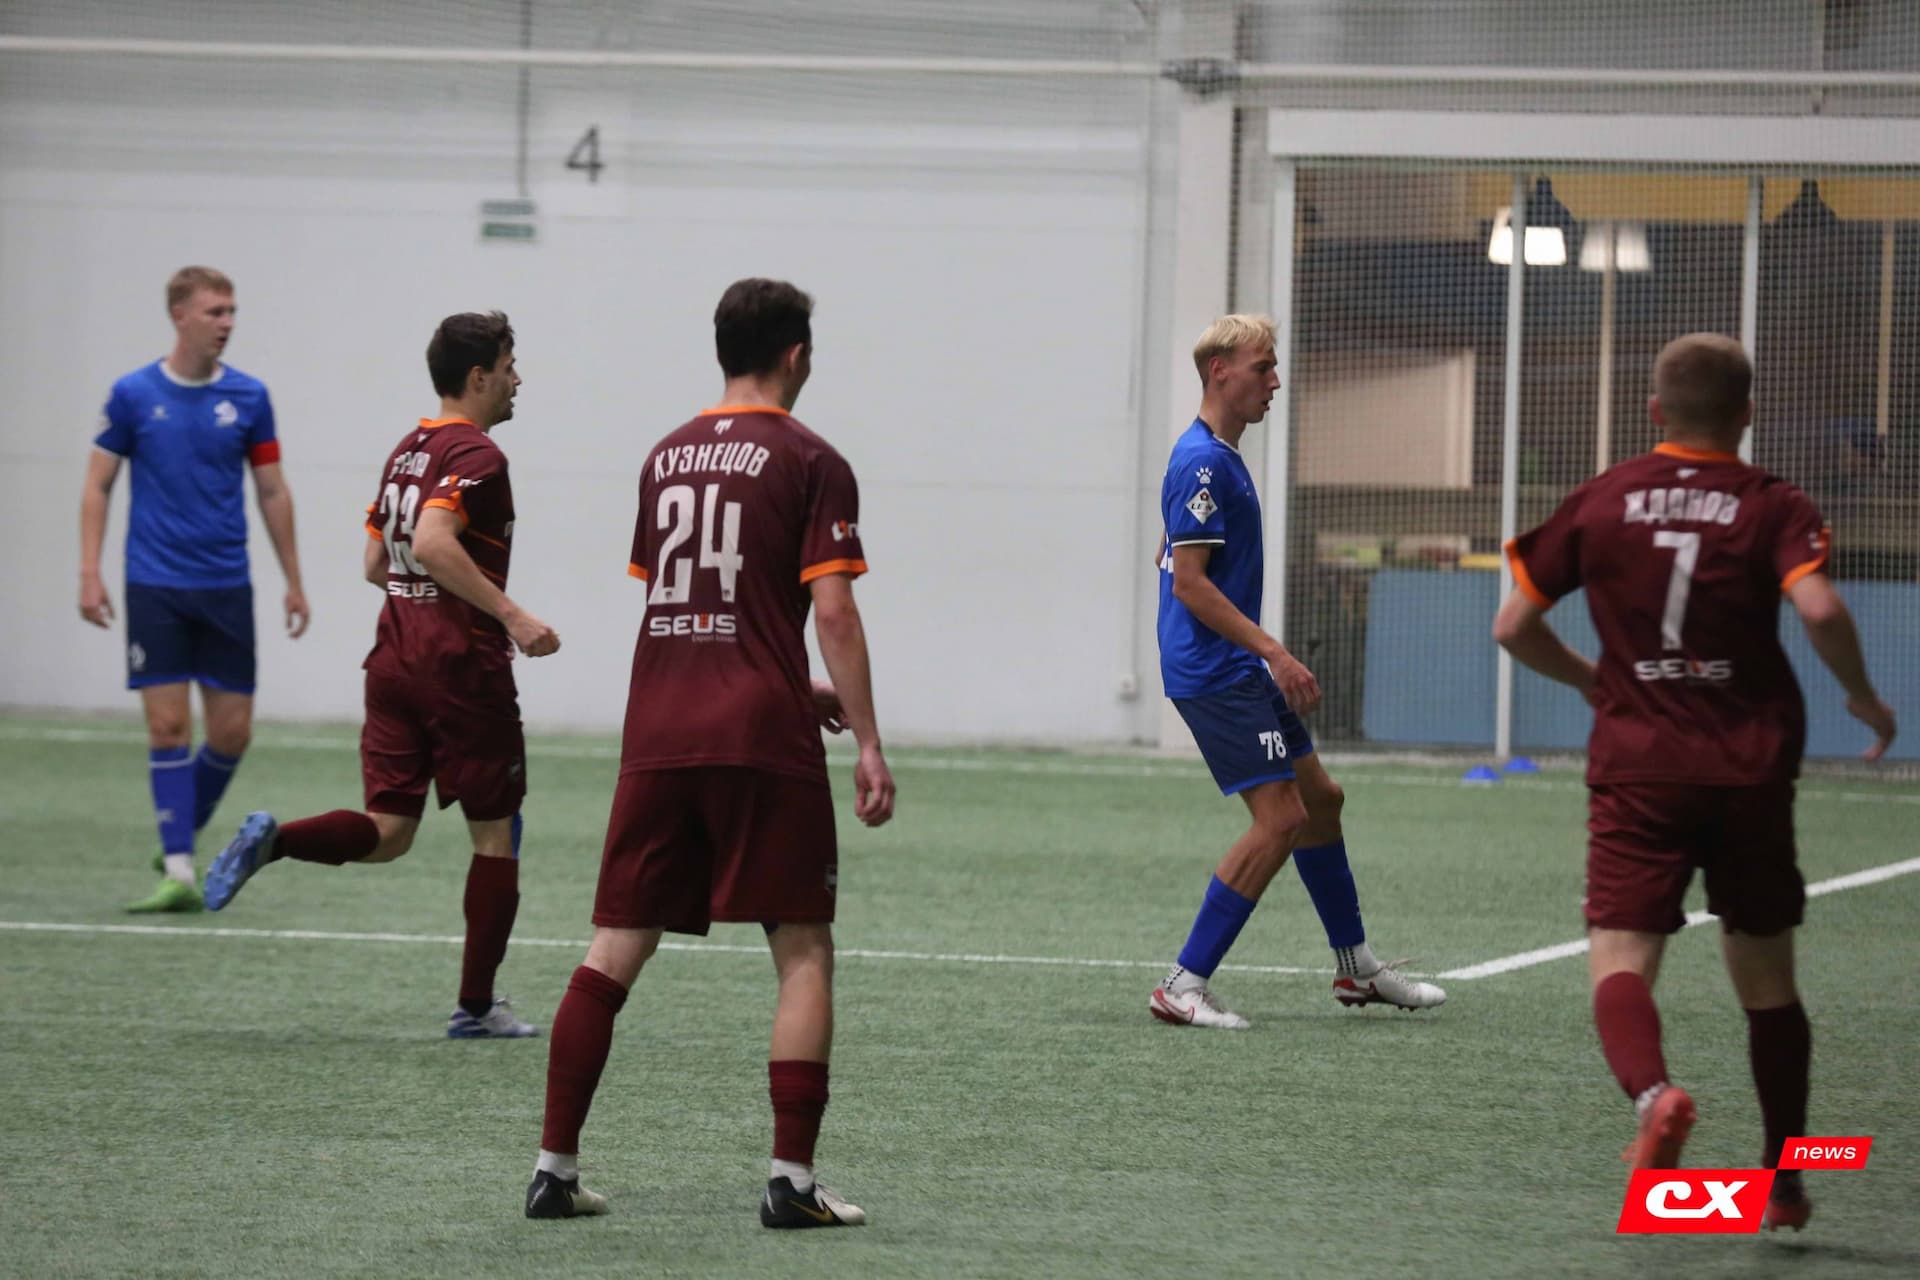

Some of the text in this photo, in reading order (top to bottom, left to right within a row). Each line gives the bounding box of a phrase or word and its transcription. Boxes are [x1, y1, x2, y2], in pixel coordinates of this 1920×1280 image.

[565, 125, 604, 184] 4
[654, 442, 770, 483] КУЗНЕЦОВ
[379, 483, 430, 576] 23
[648, 484, 744, 606] 24
[1653, 531, 1701, 650] 7
[649, 613, 736, 637] SEUS
[1634, 659, 1732, 681] SEUS
[1258, 730, 1287, 761] 78
